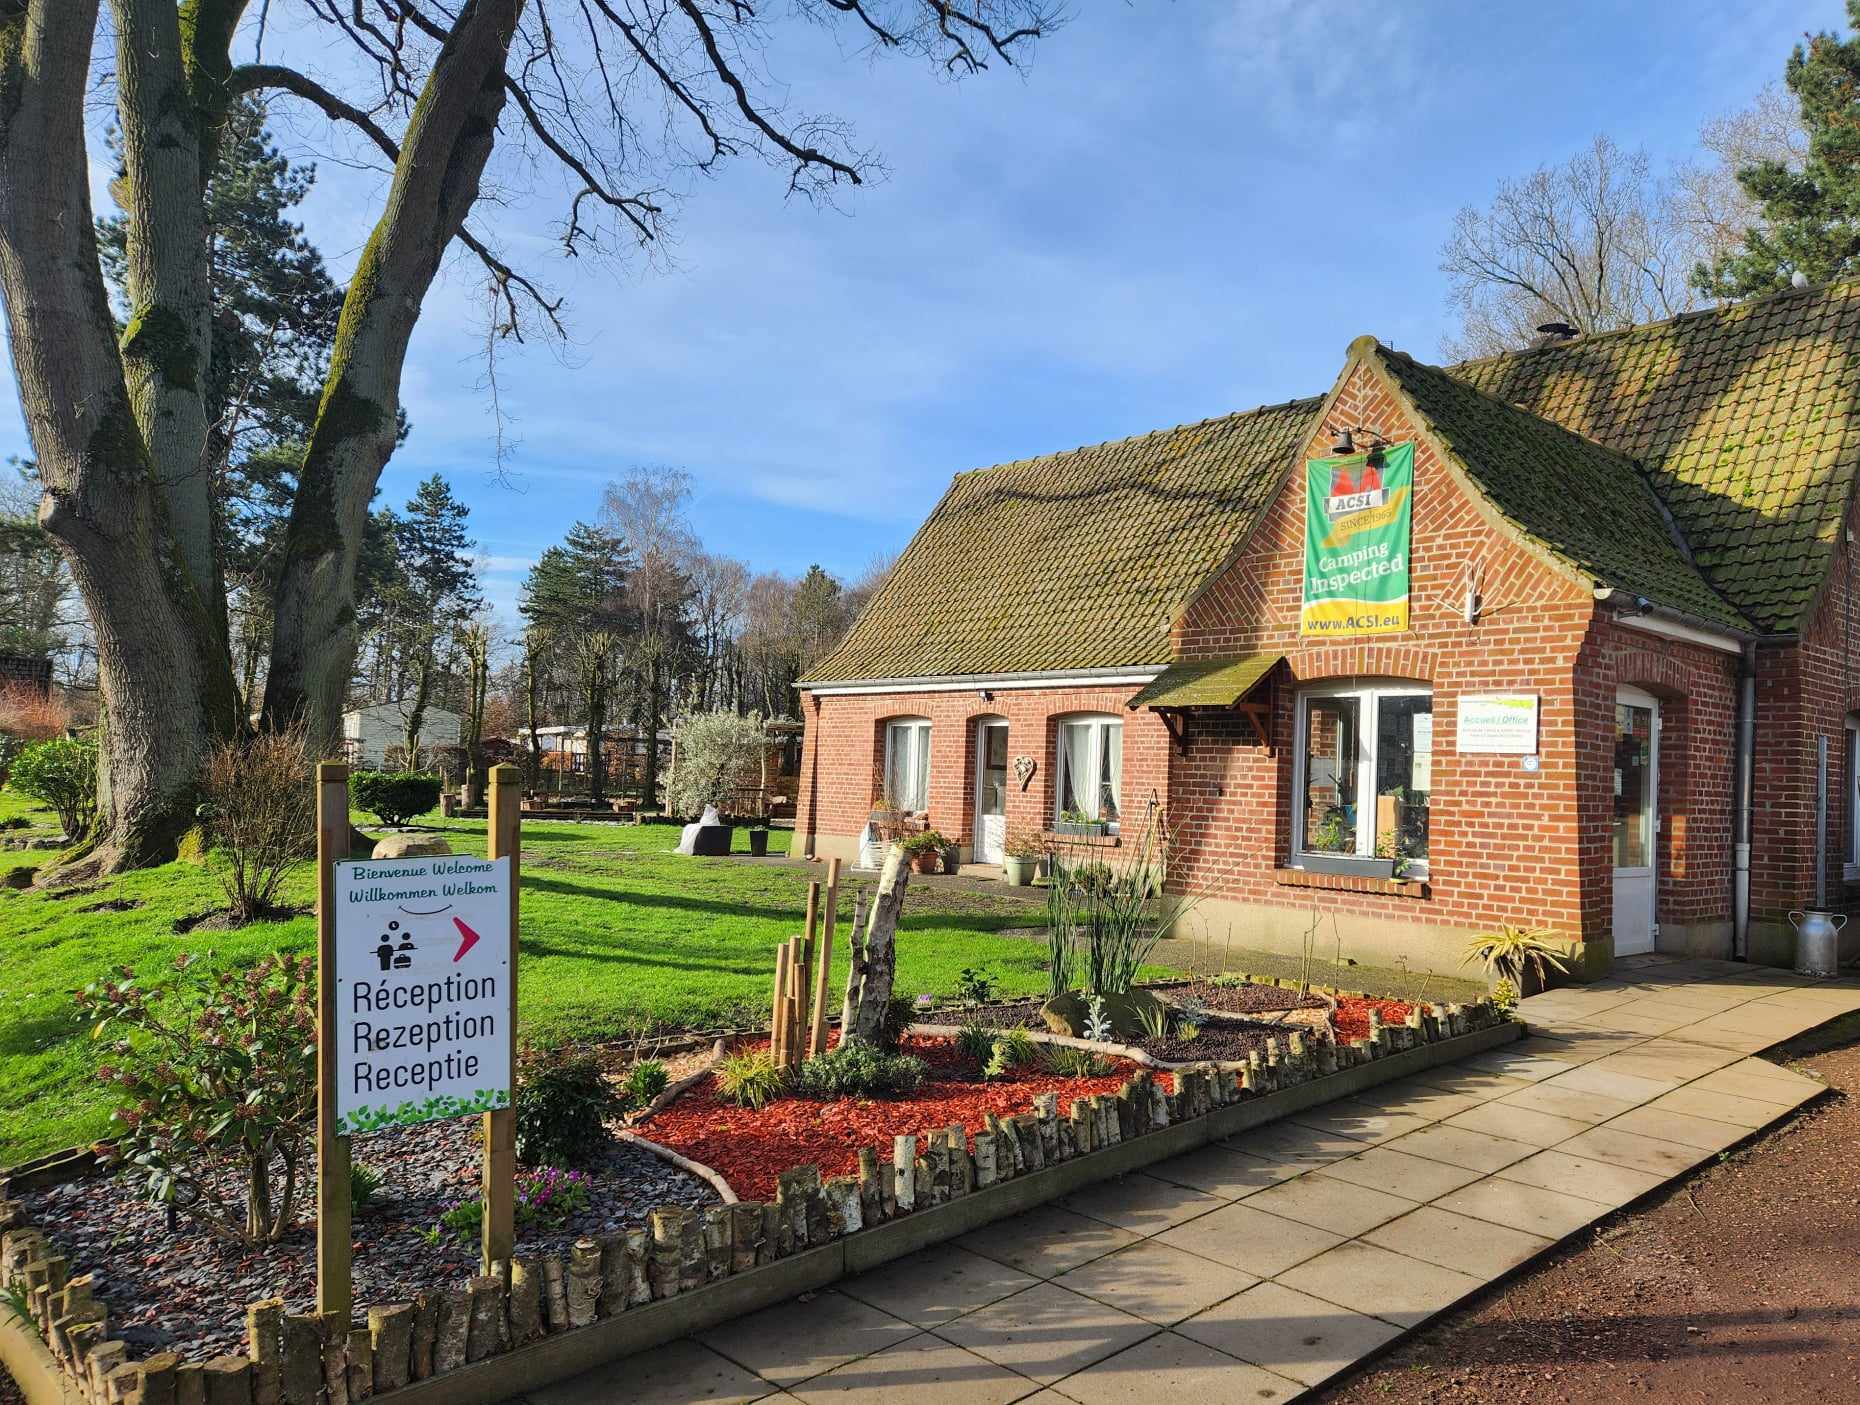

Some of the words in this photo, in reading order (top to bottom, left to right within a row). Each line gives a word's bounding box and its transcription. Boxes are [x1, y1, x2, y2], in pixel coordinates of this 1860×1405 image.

[1335, 494, 1372, 510] ACSI
[1340, 513, 1370, 531] SINCE
[1319, 542, 1389, 572] Camping
[1311, 553, 1404, 594] Inspected
[1307, 614, 1400, 630] www.ACSI.eu
[352, 866, 428, 880] Bienvenue
[432, 861, 493, 876] Welcome
[349, 887, 438, 903] Willkommen
[442, 881, 498, 897] Welkom
[353, 972, 495, 1013] Réception
[353, 1011, 494, 1053] Rezeption
[354, 1050, 479, 1094] Receptie
